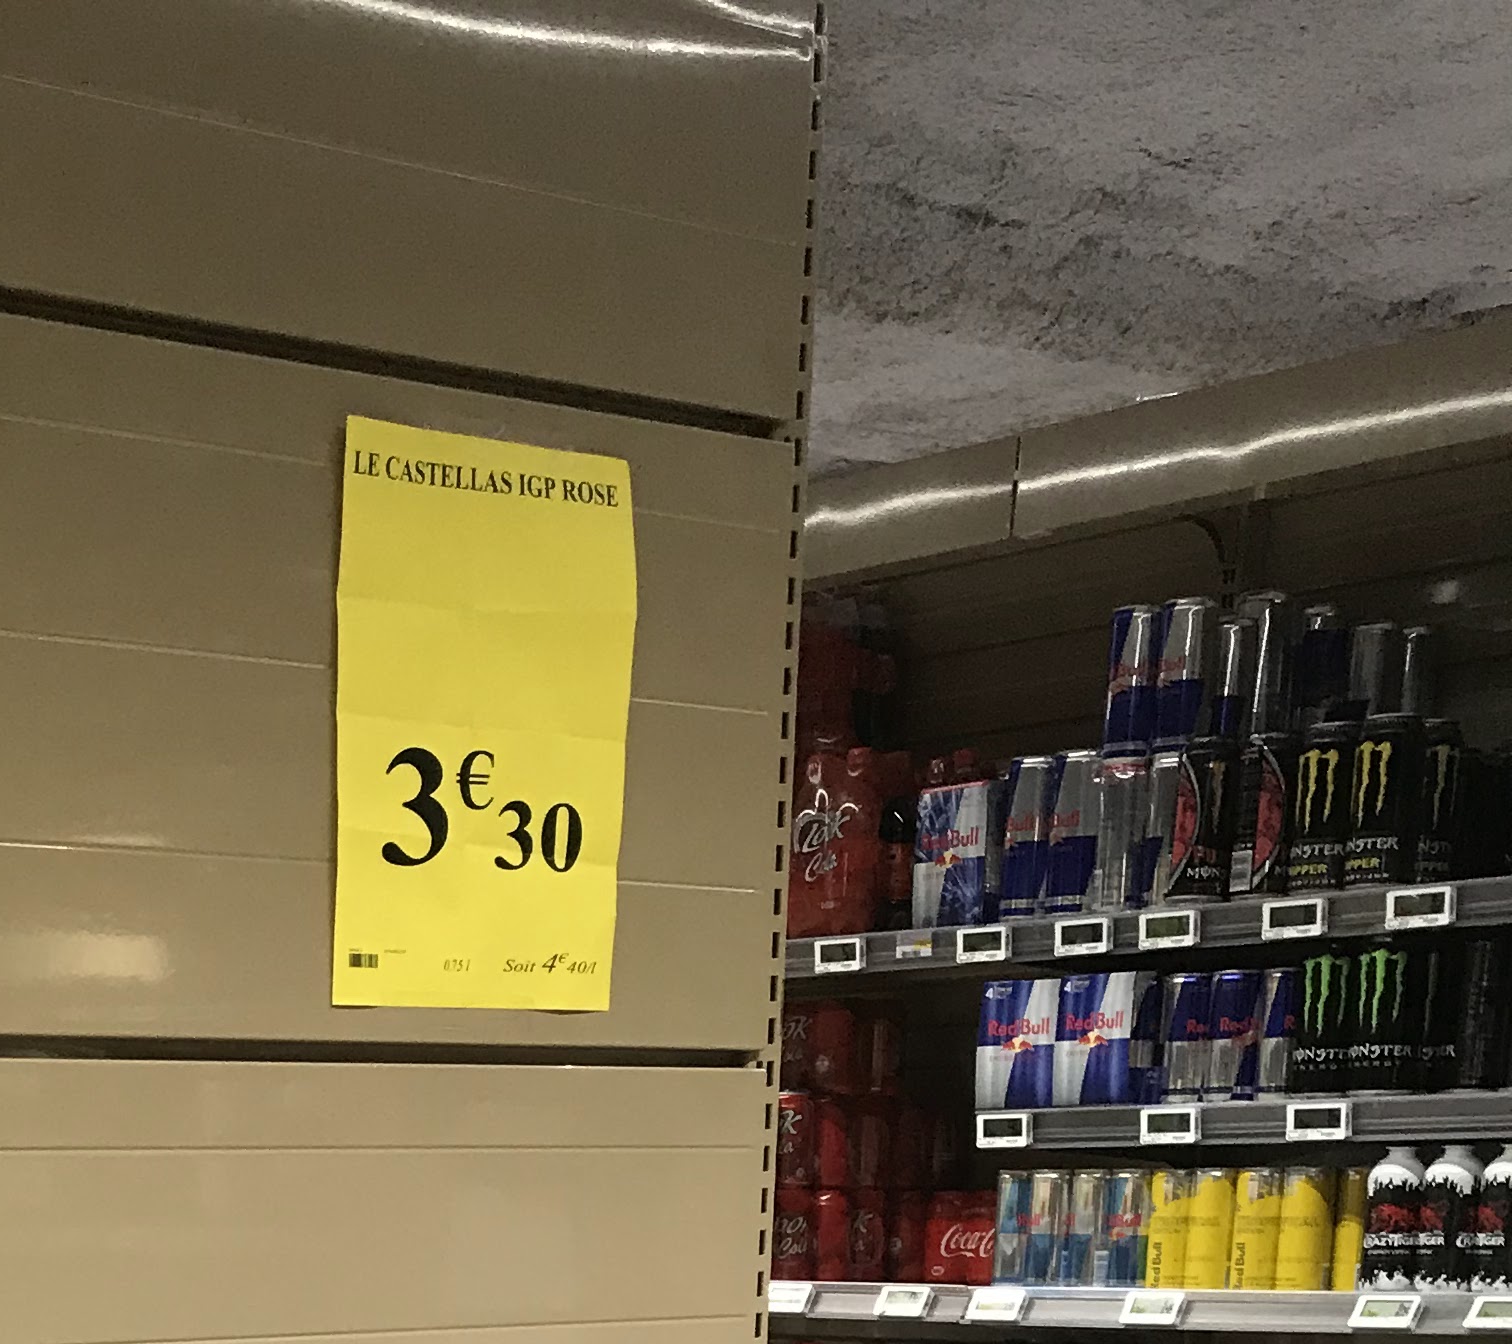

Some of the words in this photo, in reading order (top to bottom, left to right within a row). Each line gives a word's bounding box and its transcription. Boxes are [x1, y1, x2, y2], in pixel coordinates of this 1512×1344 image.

[353, 450, 380, 476] LE
[386, 456, 512, 495] CASTELLAS
[519, 474, 556, 500] IGP
[562, 480, 619, 507] ROSE
[950, 827, 980, 847] Bull
[502, 958, 536, 973] Soit
[987, 1019, 1019, 1036] Red
[1019, 1018, 1050, 1035] Bull
[1065, 1013, 1095, 1031] Red
[1095, 1010, 1124, 1030] Bull
